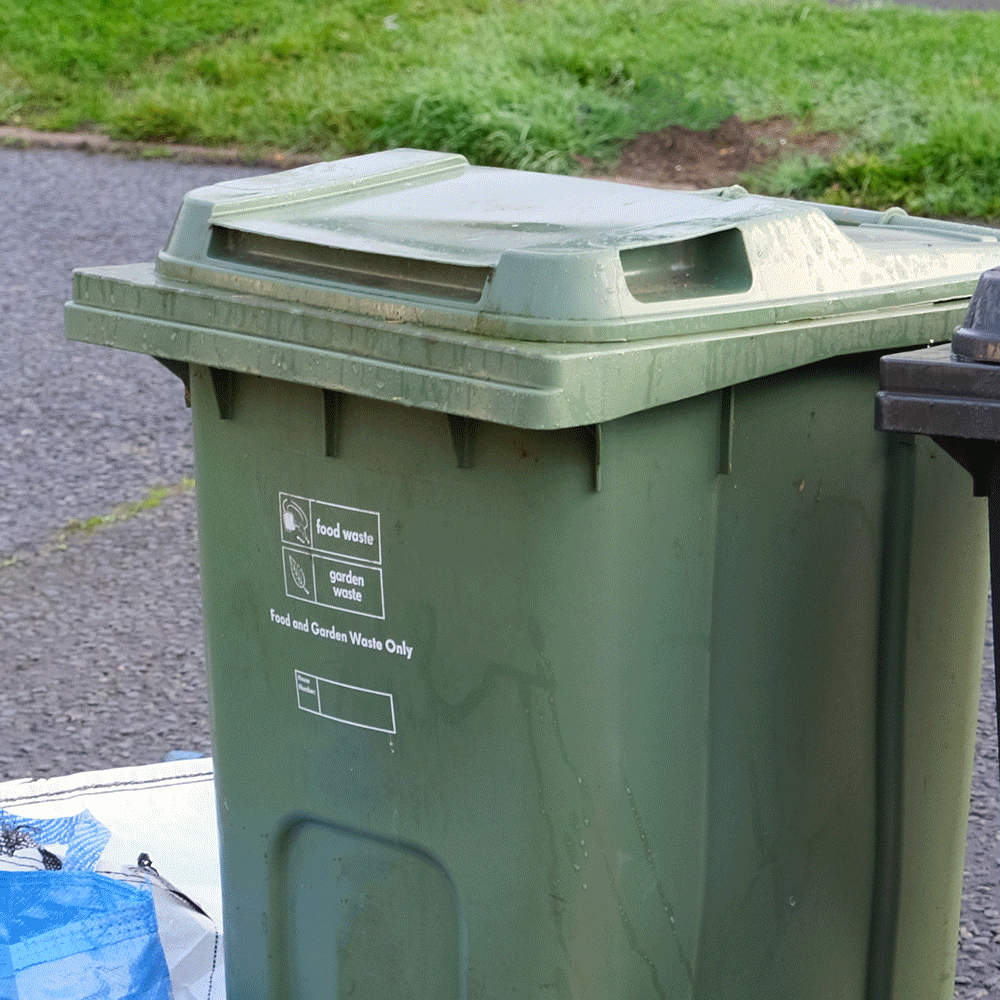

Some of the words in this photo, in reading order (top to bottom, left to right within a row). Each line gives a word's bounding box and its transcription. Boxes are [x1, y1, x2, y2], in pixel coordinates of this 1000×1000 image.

[316, 518, 341, 538] food
[342, 529, 374, 546] waste
[329, 570, 365, 587] garden
[333, 586, 363, 602] waste
[270, 608, 291, 627] Food
[292, 619, 309, 633] and
[311, 622, 348, 643] Garden
[349, 631, 383, 651] Waste
[385, 639, 413, 660] Only
